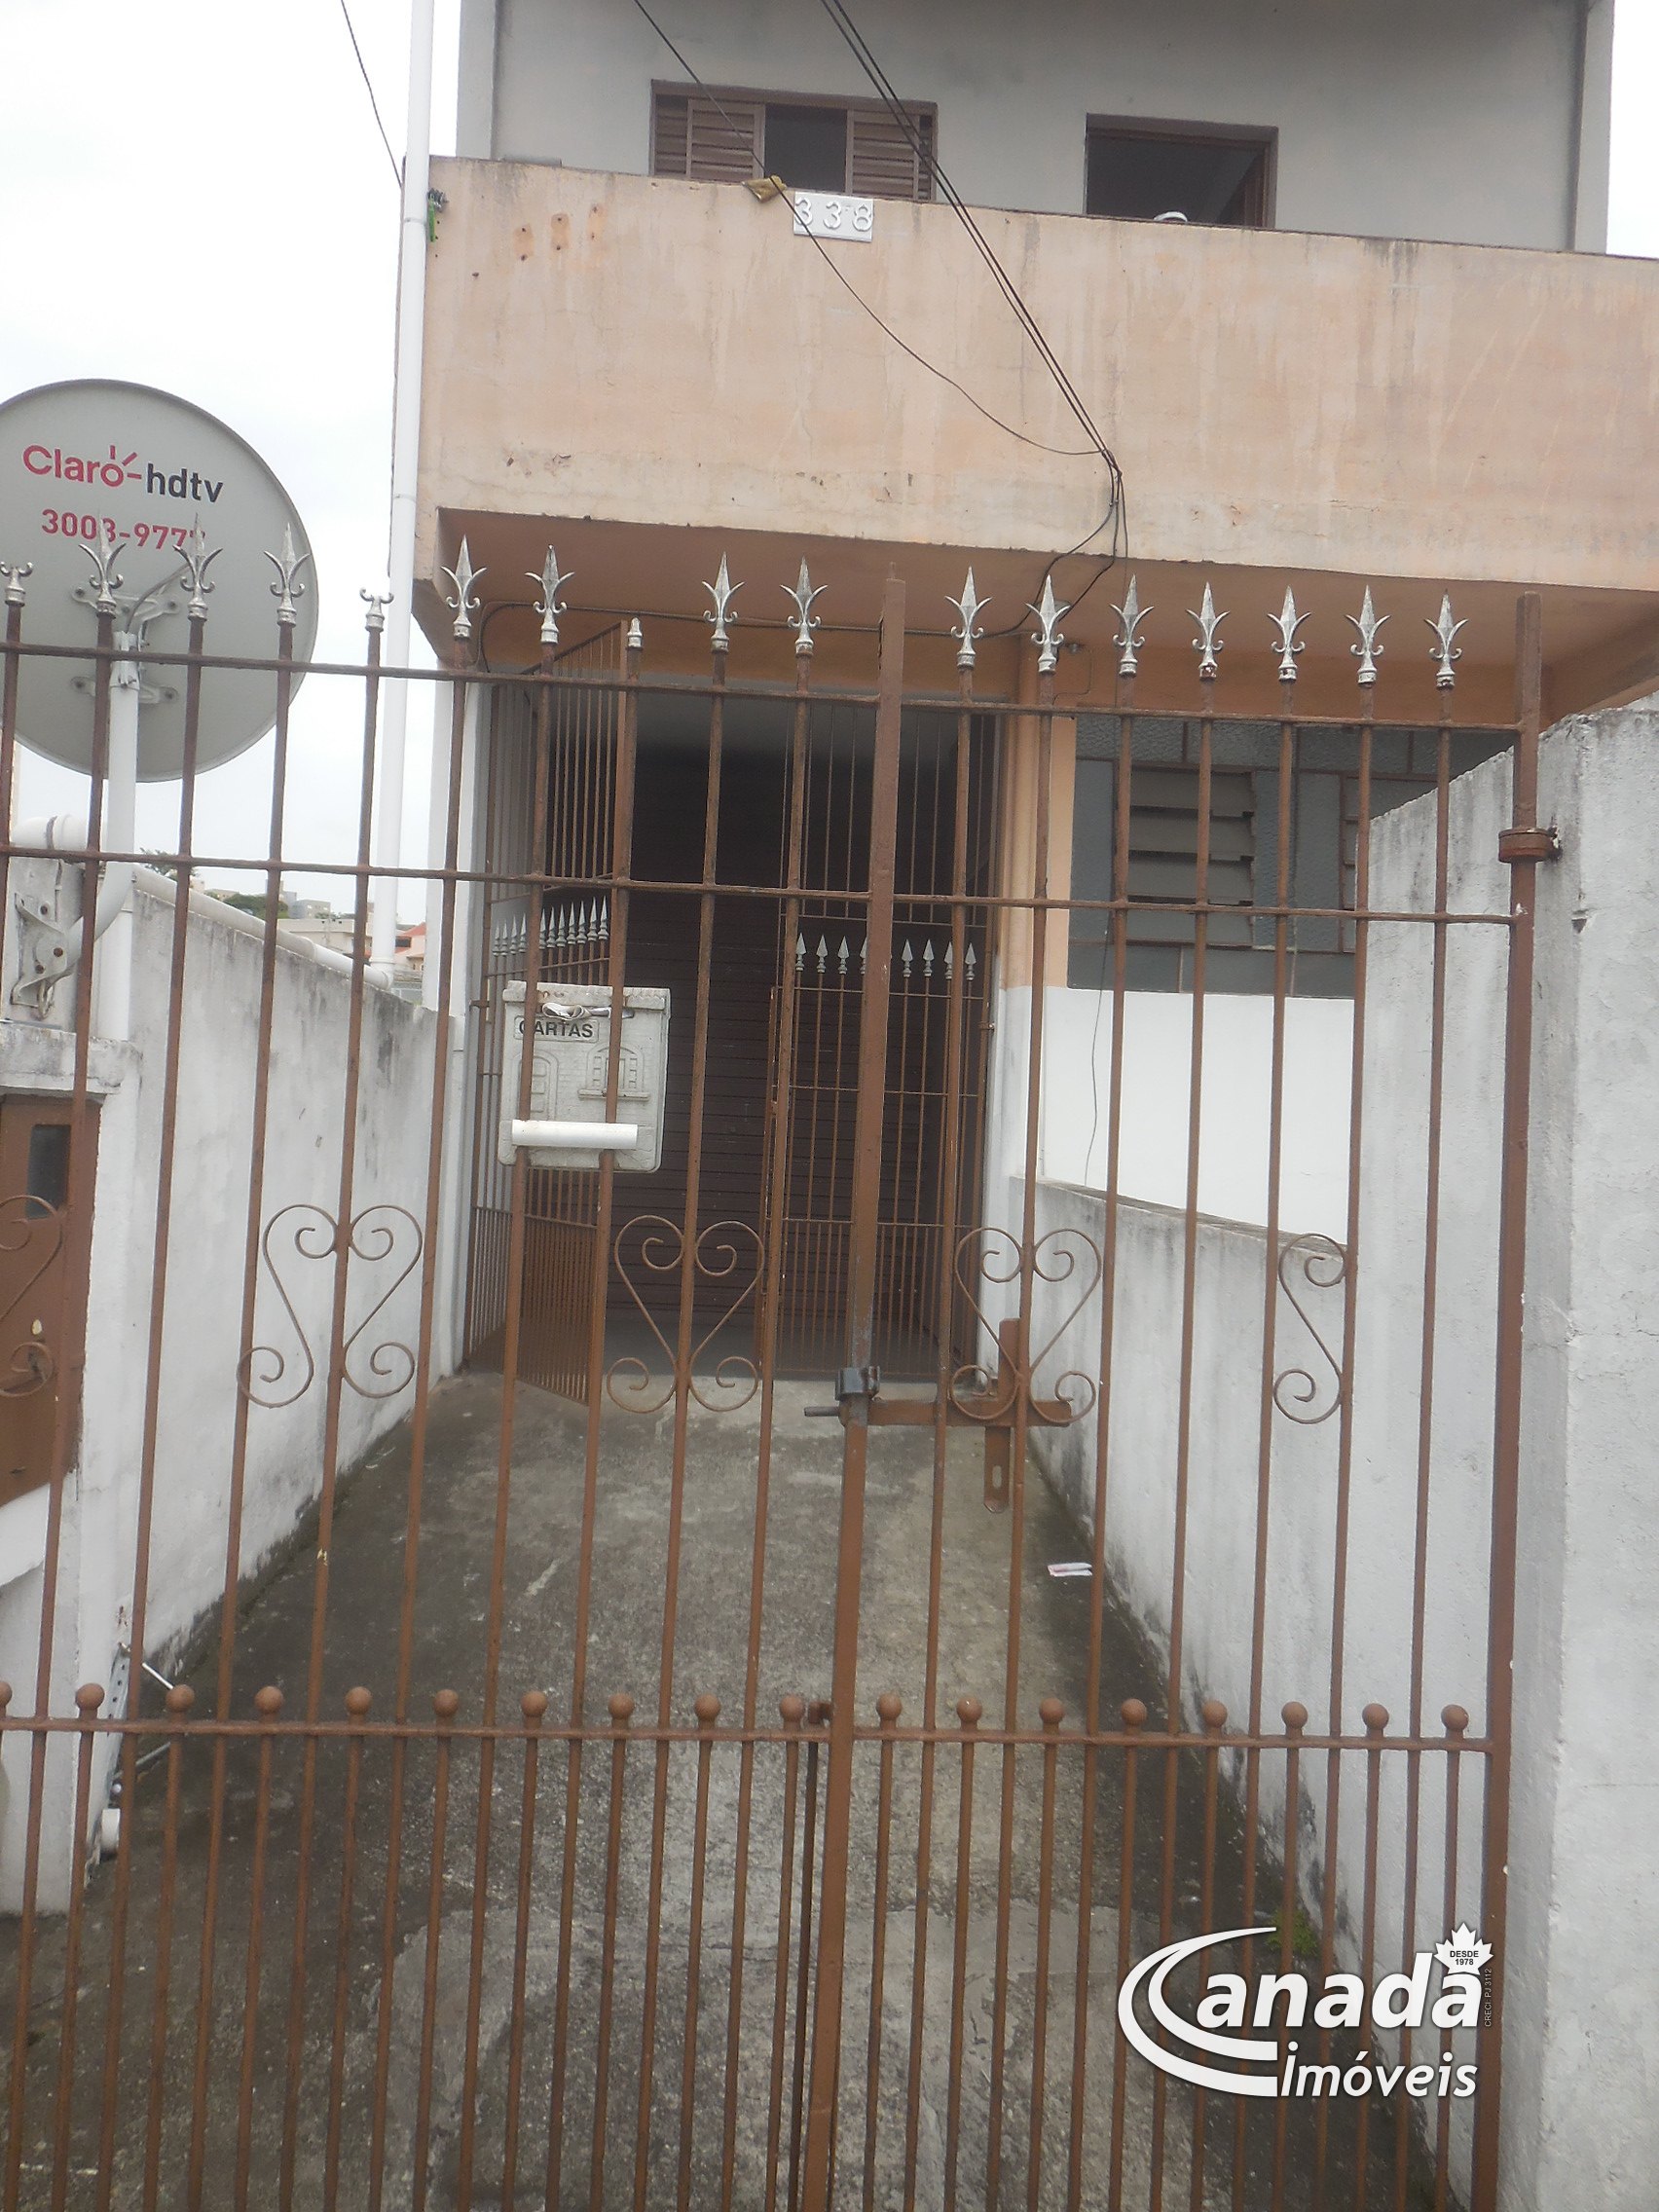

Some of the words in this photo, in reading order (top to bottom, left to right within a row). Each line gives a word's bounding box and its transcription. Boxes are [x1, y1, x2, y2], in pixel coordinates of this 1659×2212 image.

[794, 197, 873, 232] 338
[22, 444, 126, 487] Claro
[147, 462, 224, 503] hdtv
[42, 508, 206, 550] 3003-977
